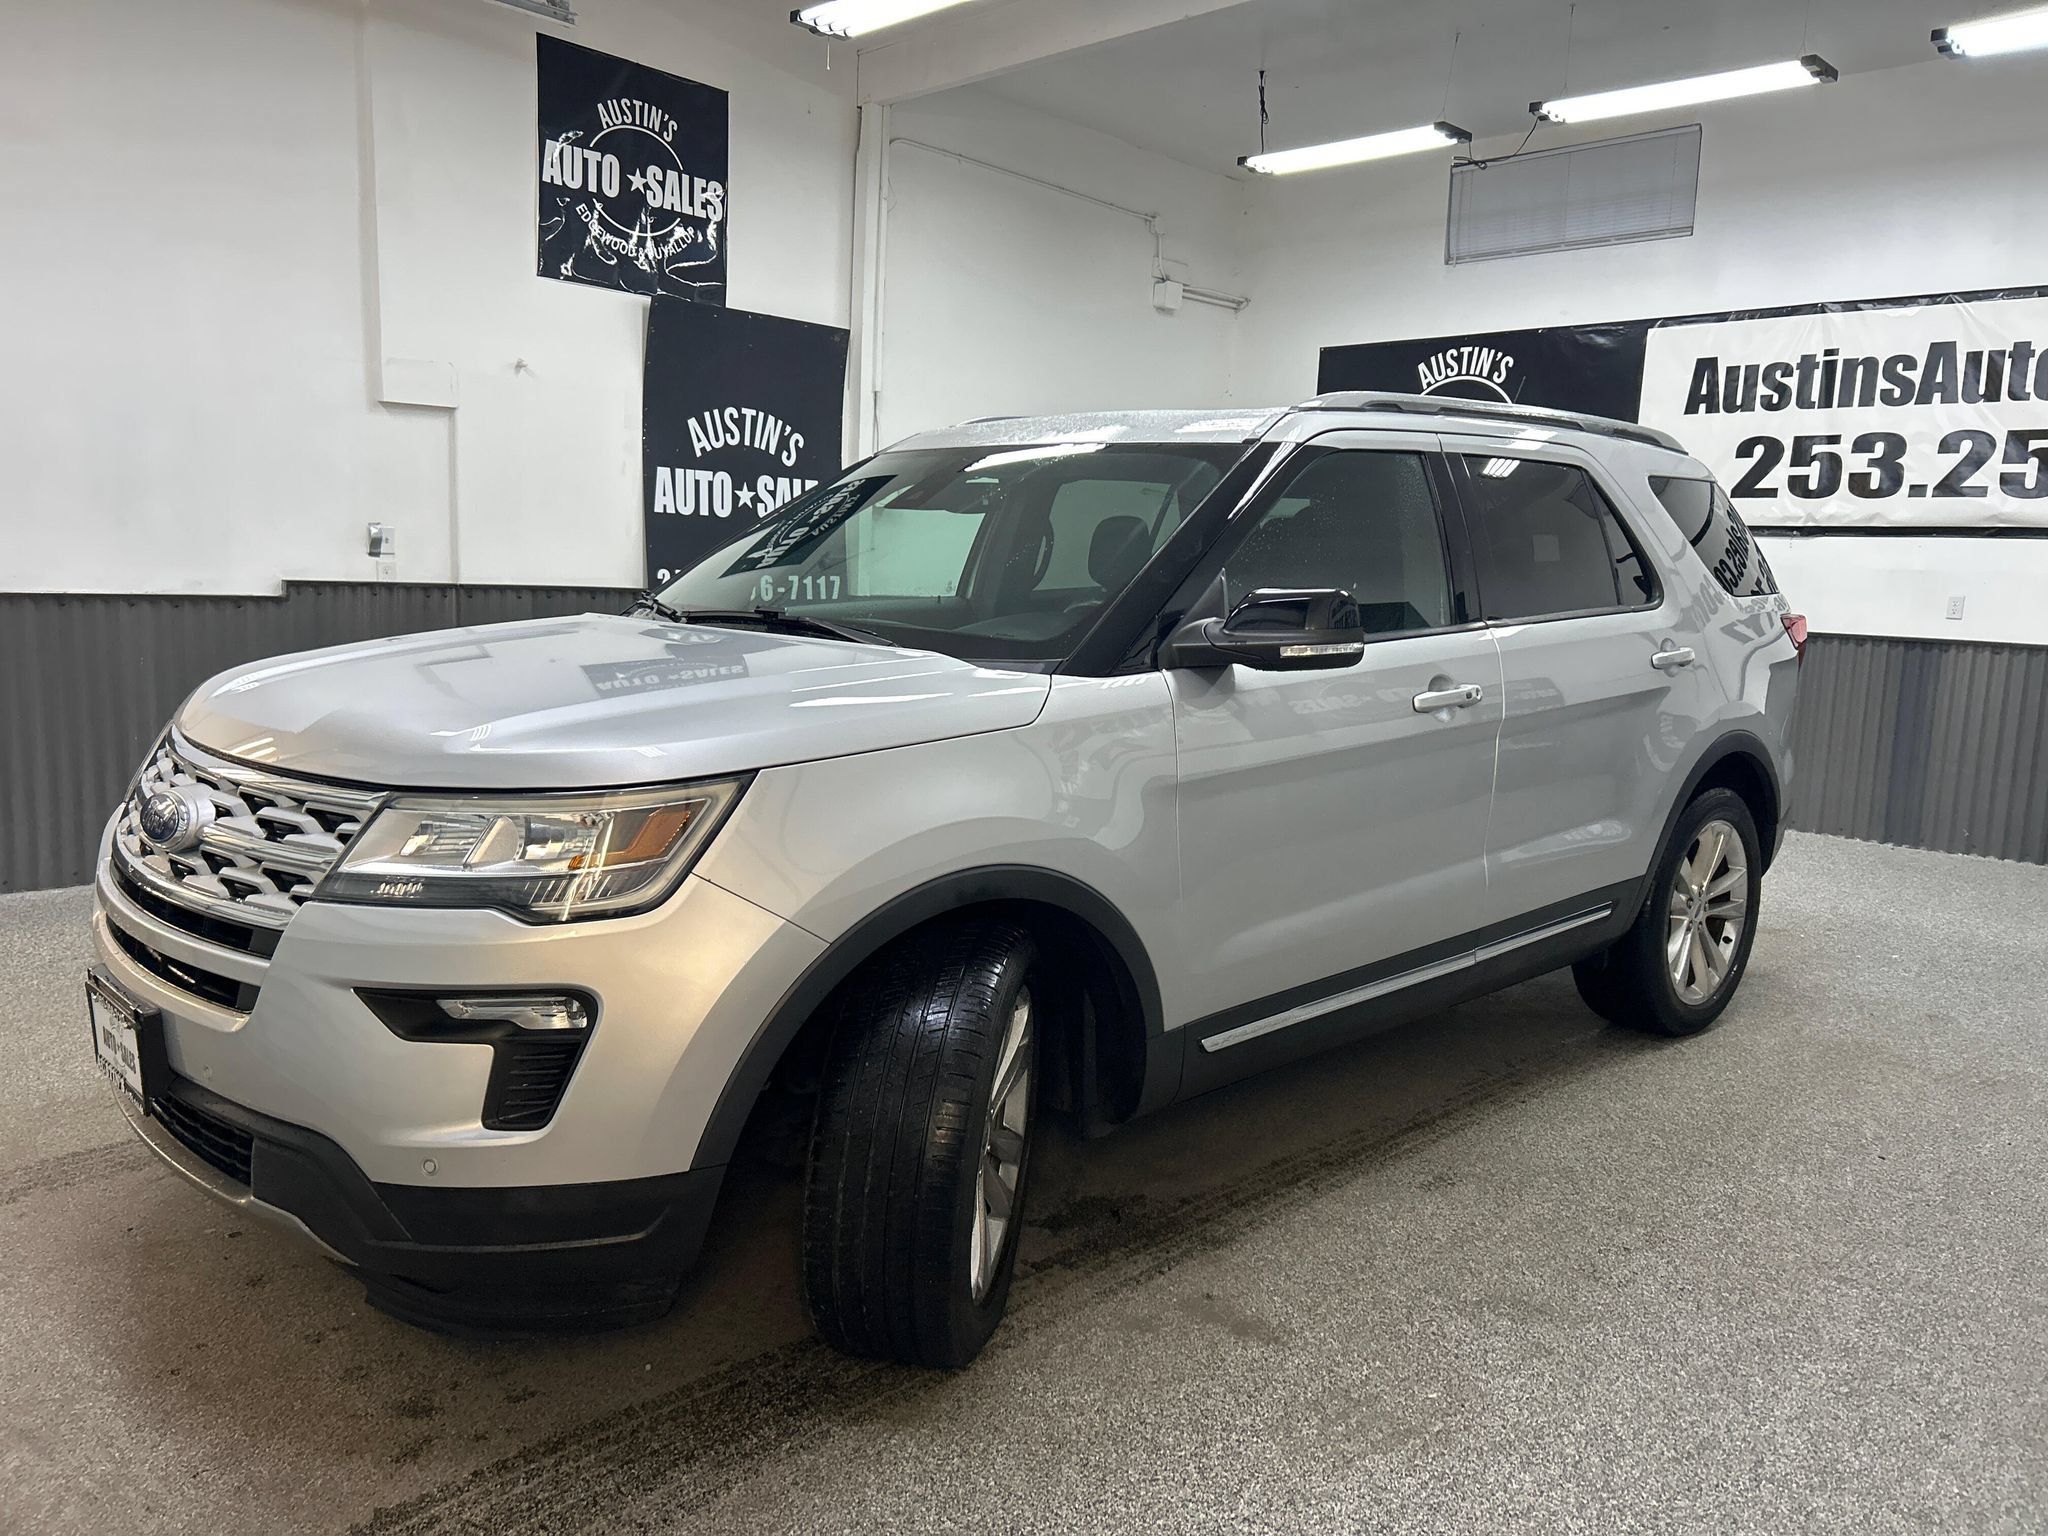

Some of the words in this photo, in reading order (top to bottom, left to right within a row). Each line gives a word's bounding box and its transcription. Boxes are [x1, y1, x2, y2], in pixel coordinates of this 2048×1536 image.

[597, 98, 678, 142] AUSTIN'S
[542, 139, 620, 198] AUTO
[646, 165, 724, 221] SALES
[648, 226, 696, 259] UYALLUP
[1417, 346, 1514, 390] AUSTIN'S
[687, 406, 804, 467] AUSTIN'S
[1730, 429, 2048, 499] 253.25
[654, 466, 734, 518] AUTO
[751, 575, 841, 602] 6-7117
